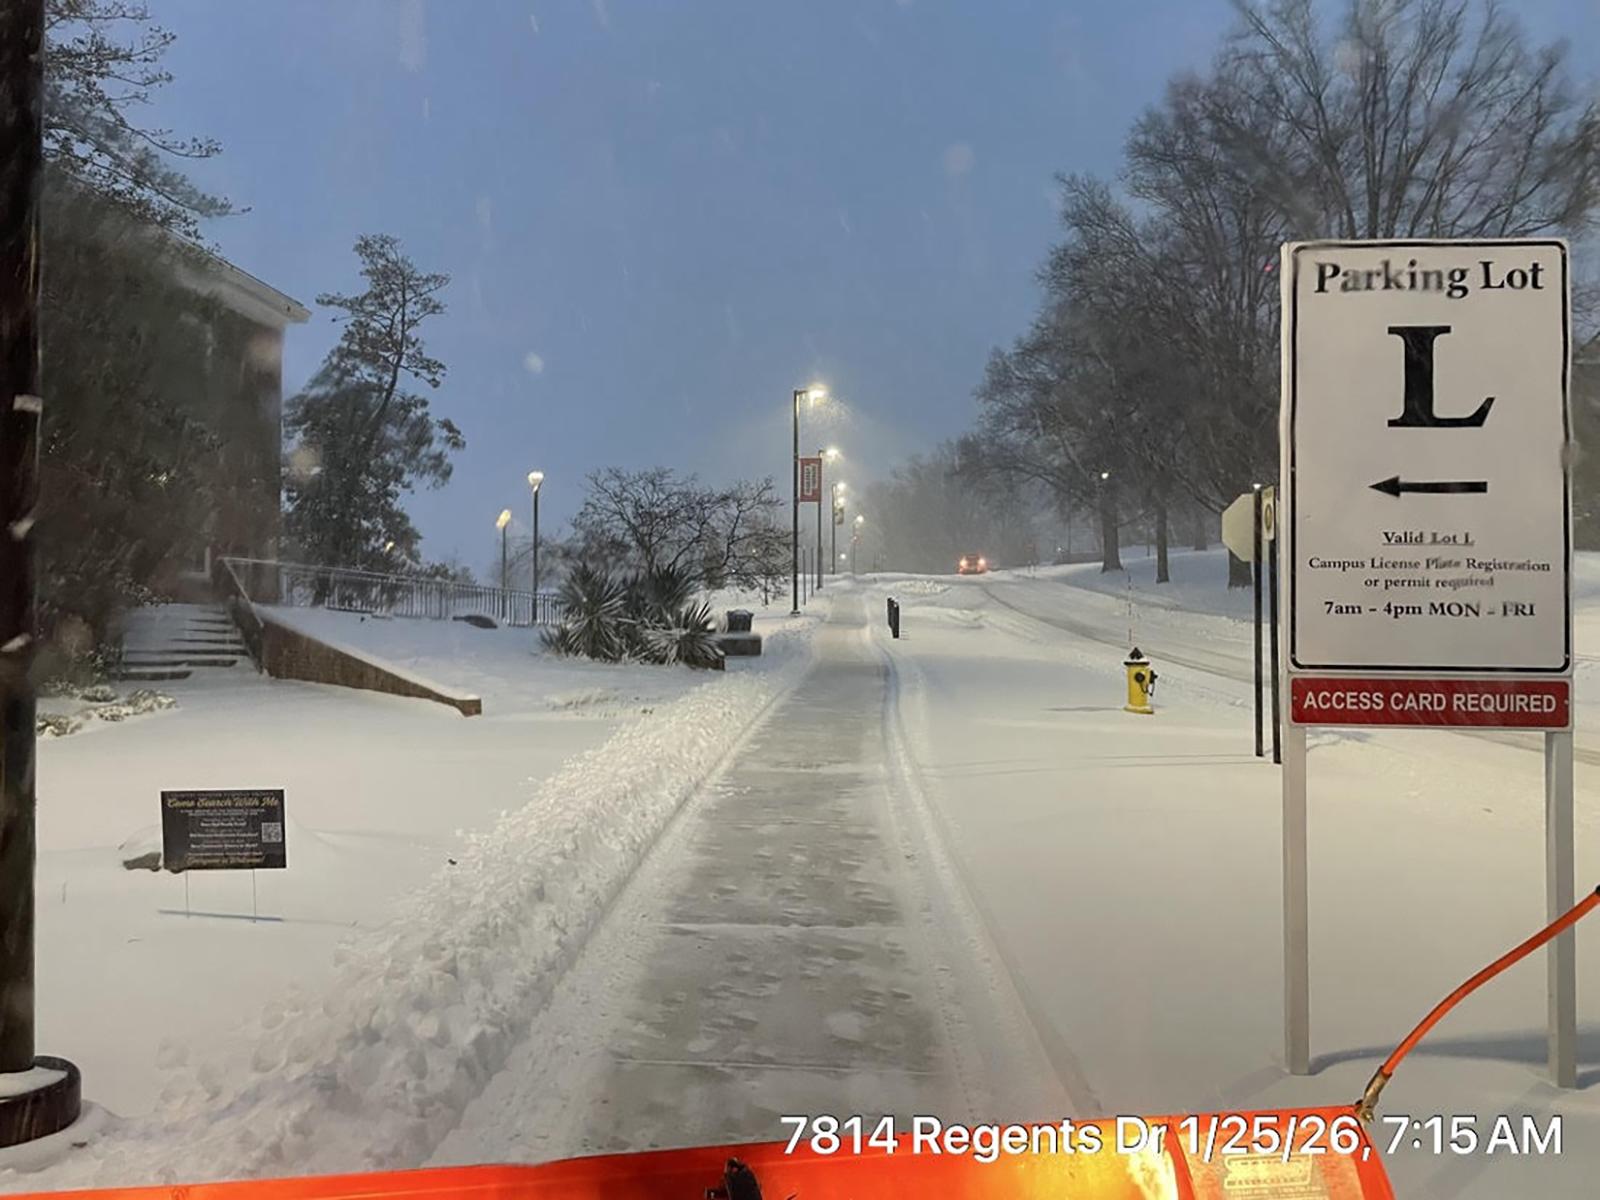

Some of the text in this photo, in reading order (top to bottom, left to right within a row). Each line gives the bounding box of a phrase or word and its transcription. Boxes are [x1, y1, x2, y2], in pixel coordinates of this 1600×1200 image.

[1314, 259, 1544, 299] Parking Lot
[1387, 325, 1496, 428] L
[1383, 531, 1424, 544] Valid
[1431, 532, 1457, 544] Lot
[1308, 556, 1551, 572] Campus License Plate Registration
[1364, 576, 1494, 591] or permit required
[1324, 601, 1362, 615] 7am
[1383, 601, 1422, 619] 4pm
[1428, 602, 1480, 617] MON
[1502, 602, 1536, 617] FRI
[1303, 691, 1556, 713] ACCESS CARD REQUIRED
